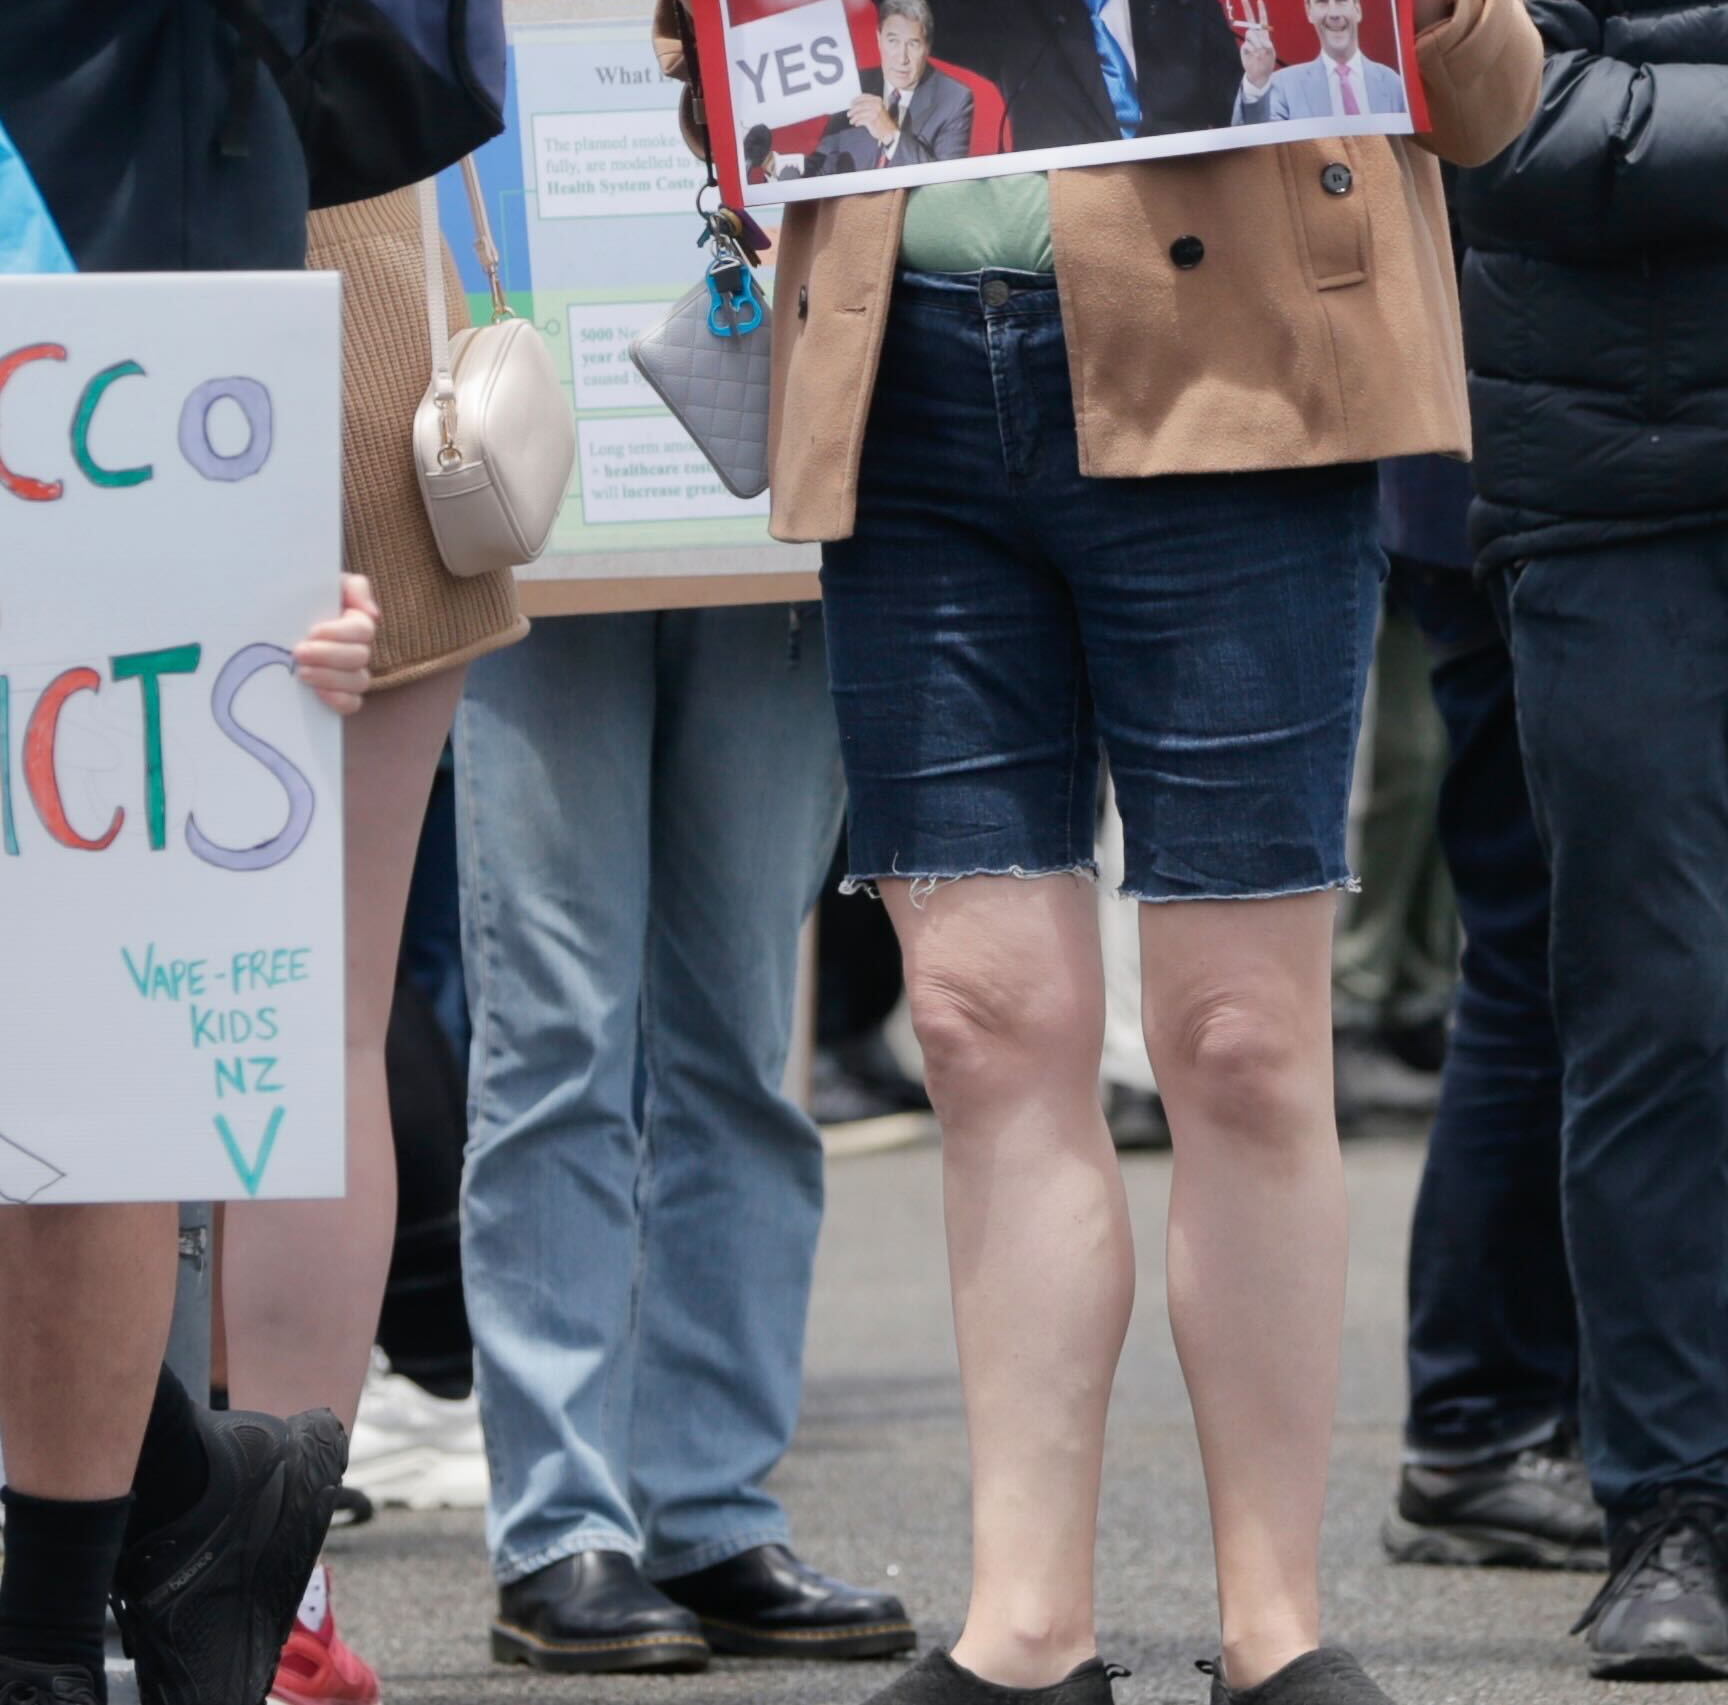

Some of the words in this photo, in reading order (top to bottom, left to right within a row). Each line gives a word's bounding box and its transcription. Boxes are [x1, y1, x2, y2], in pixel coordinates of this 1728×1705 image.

[594, 66, 652, 86] What
[735, 35, 847, 105] YES
[547, 180, 596, 196] Health
[599, 178, 651, 196] System
[656, 176, 695, 190] Costs
[604, 462, 680, 478] healthcare
[623, 483, 681, 500] increase
[121, 941, 312, 1001] VAPE-FREE
[190, 1003, 279, 1048] KIDS
[214, 1056, 286, 1100] NZ
